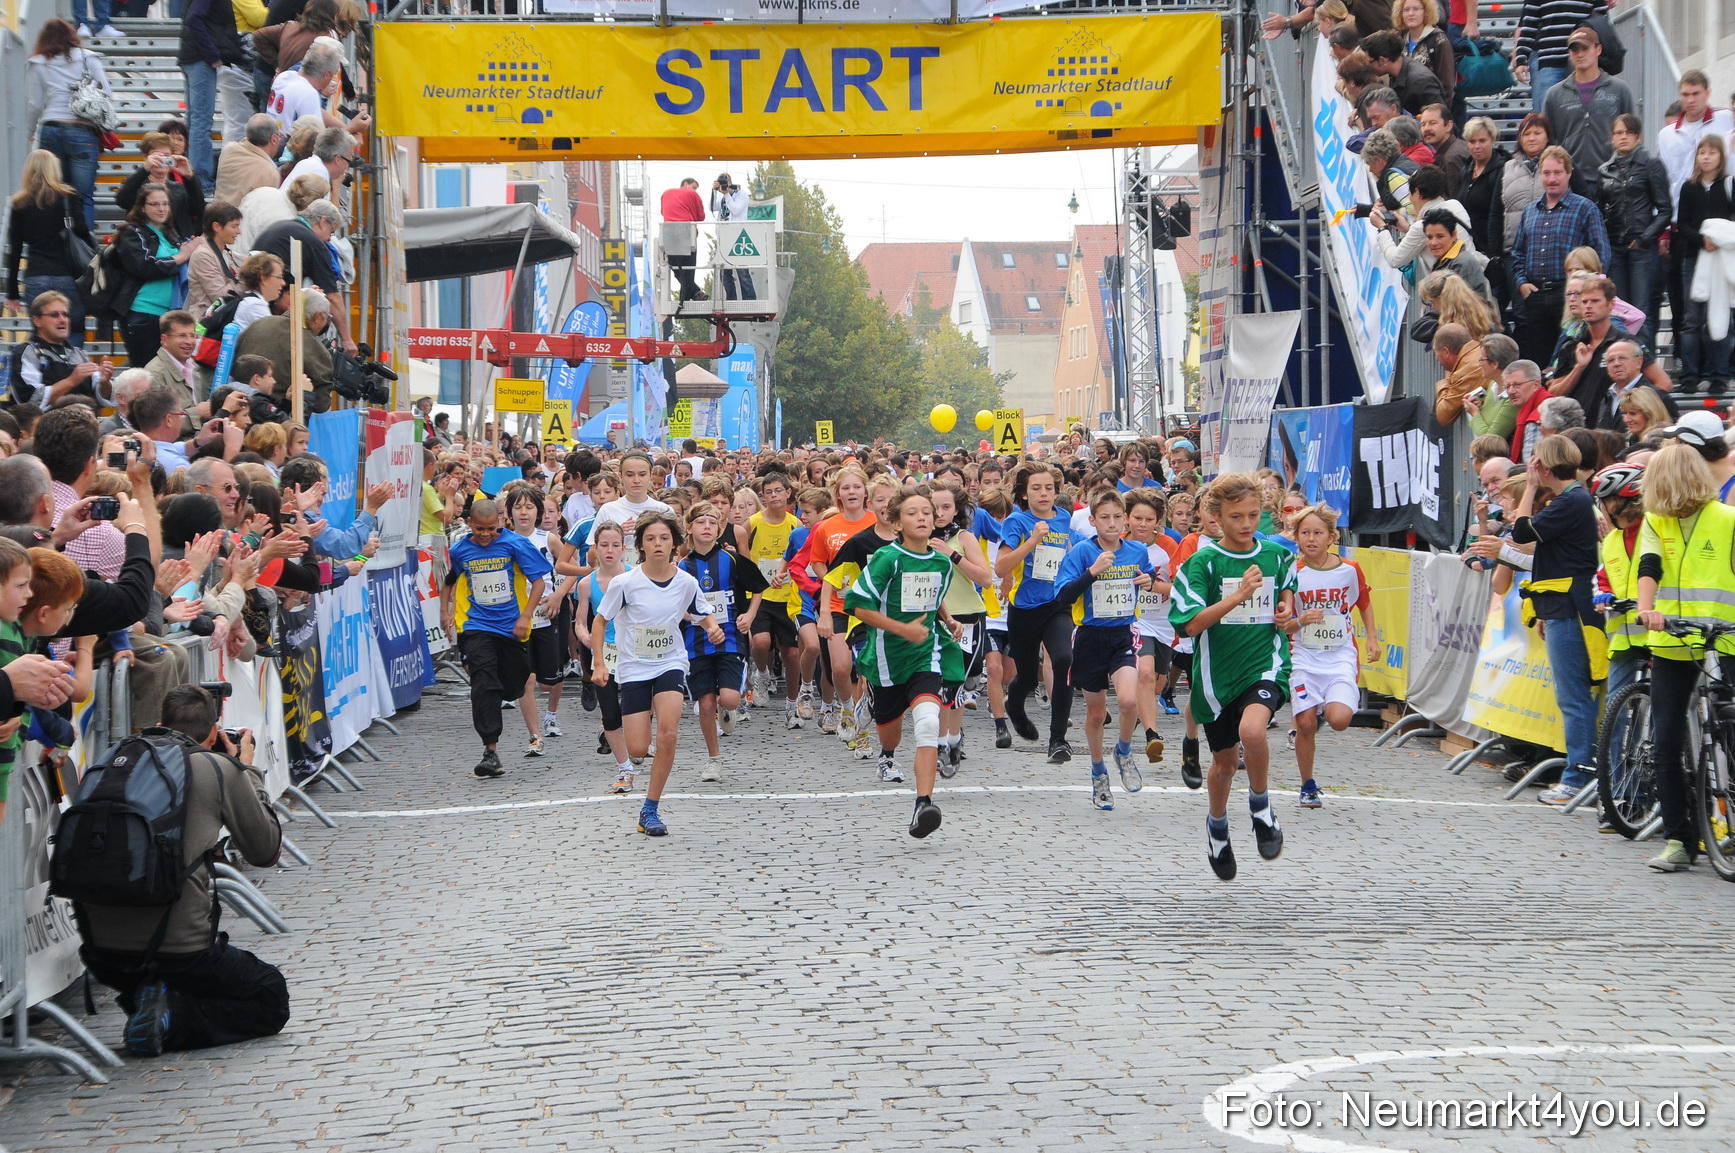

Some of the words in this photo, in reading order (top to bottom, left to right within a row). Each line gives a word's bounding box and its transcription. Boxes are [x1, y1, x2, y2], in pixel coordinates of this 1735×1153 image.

[654, 46, 940, 115] START
[993, 79, 1092, 95] Neumarkter
[1095, 76, 1174, 93] Stadtlauf
[422, 84, 522, 99] Neumarkter
[526, 85, 604, 100] Stadtlauf
[418, 335, 447, 346] 09181
[585, 343, 611, 353] 6352
[731, 360, 754, 372] maxi
[497, 387, 541, 396] Schnupper-
[544, 401, 568, 410] Block
[996, 410, 1021, 420] Block
[547, 413, 565, 435] A
[820, 427, 830, 440] B
[1000, 422, 1018, 445] A
[914, 574, 931, 583] Patrik
[482, 582, 507, 594] 4158
[1104, 581, 1132, 591] Christoph
[914, 587, 938, 599] 4115
[1105, 593, 1133, 605] 4134
[1140, 594, 1158, 605] 068
[645, 628, 666, 636] Philipp
[1314, 629, 1344, 639] 4064
[646, 635, 674, 649] 4098
